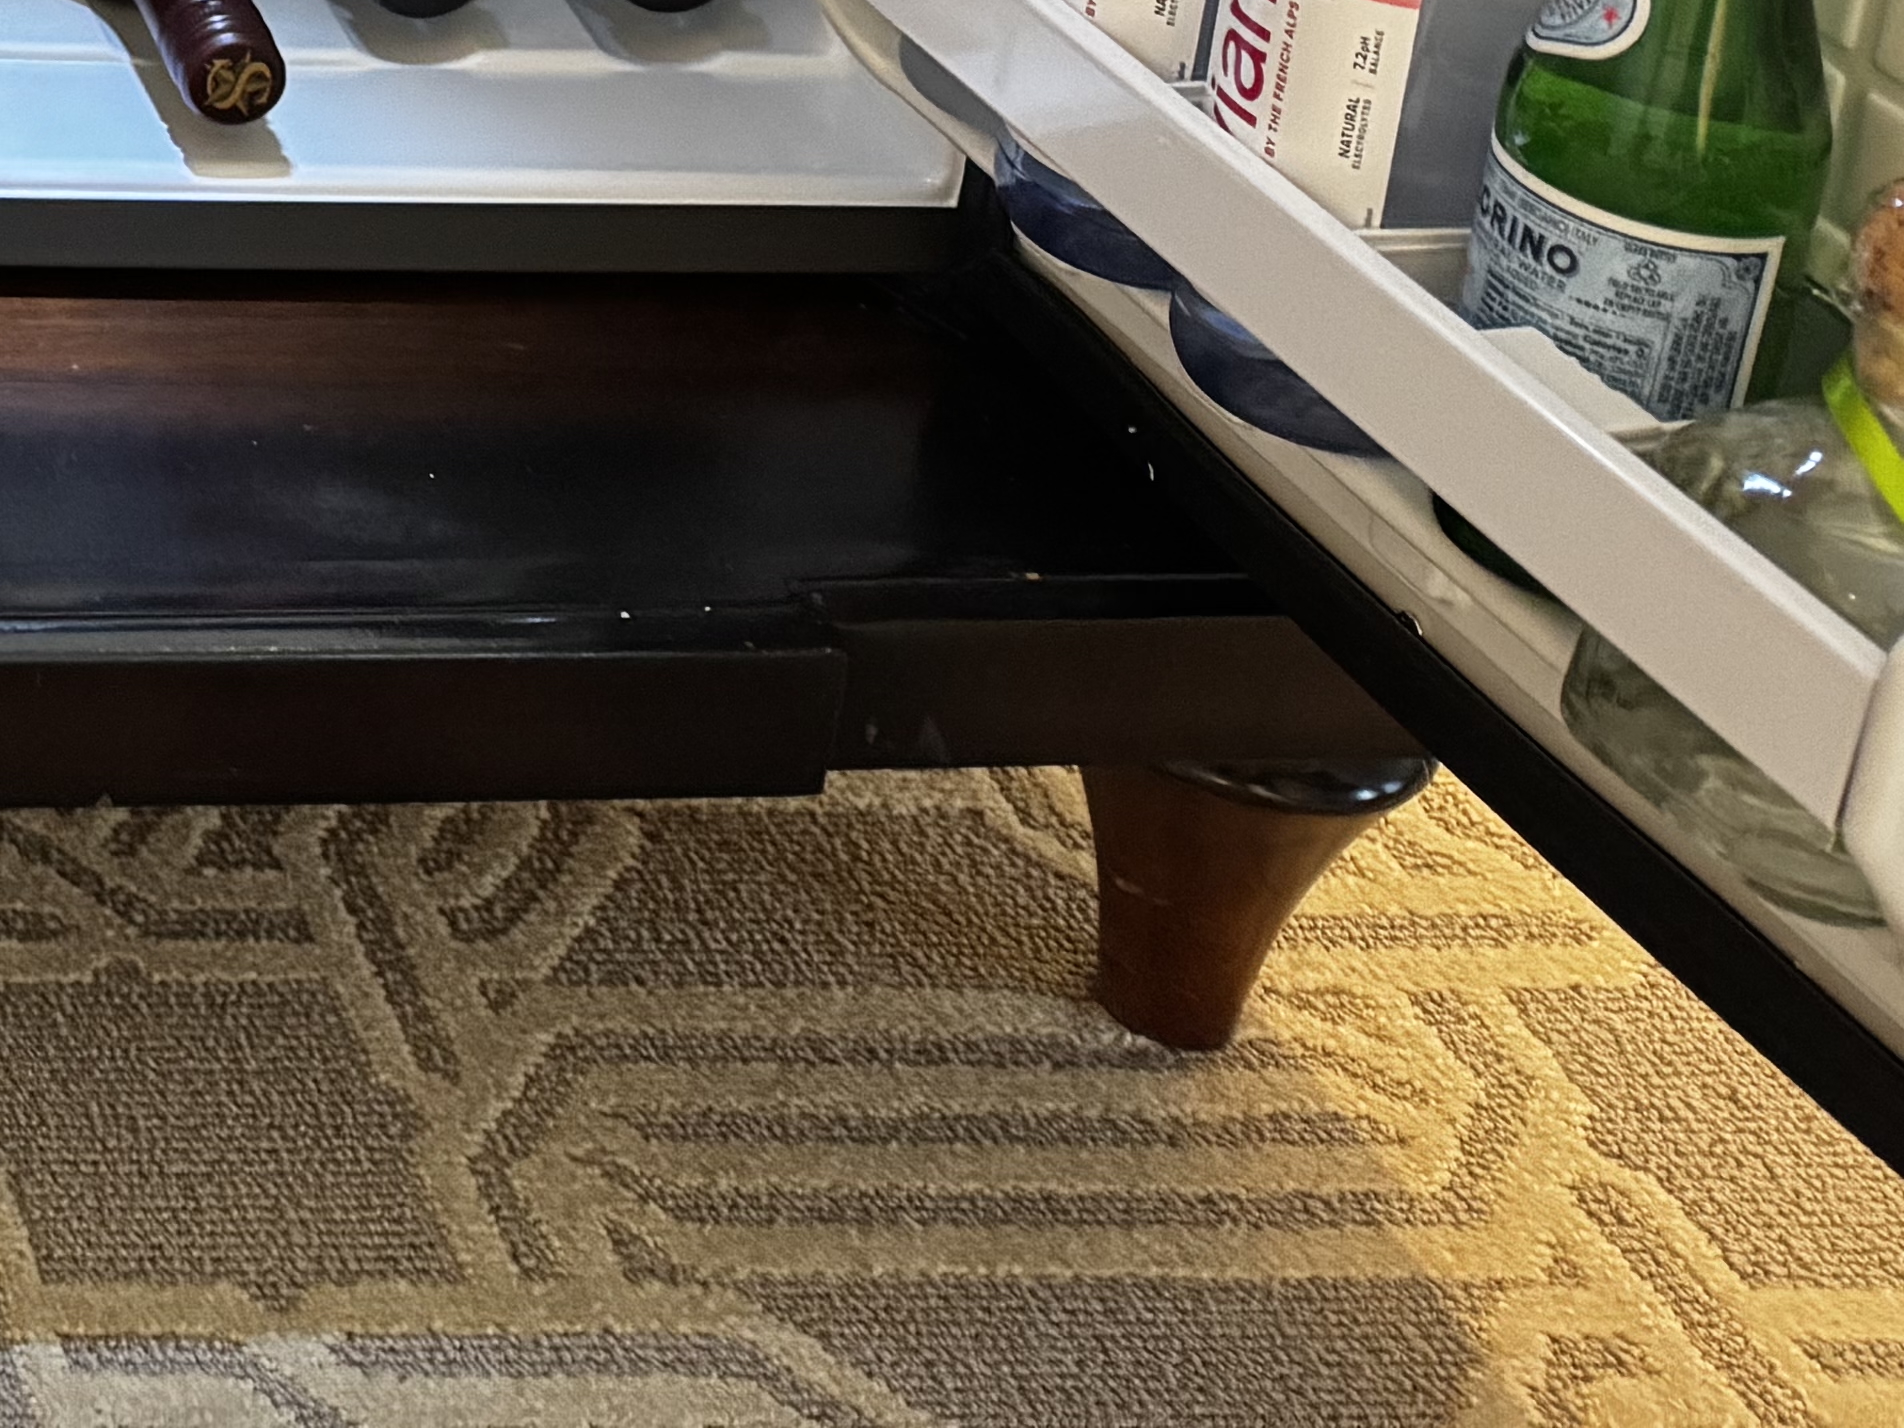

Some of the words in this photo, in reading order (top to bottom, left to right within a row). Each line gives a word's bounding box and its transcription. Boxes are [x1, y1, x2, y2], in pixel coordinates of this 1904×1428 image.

[1284, 1, 1300, 40] ALPS
[1273, 46, 1292, 102] FRENCH
[1269, 105, 1282, 133] THE
[1338, 97, 1360, 159] NATURAL
[1352, 98, 1372, 170] ELECTROLYTES
[1264, 137, 1276, 158] BY
